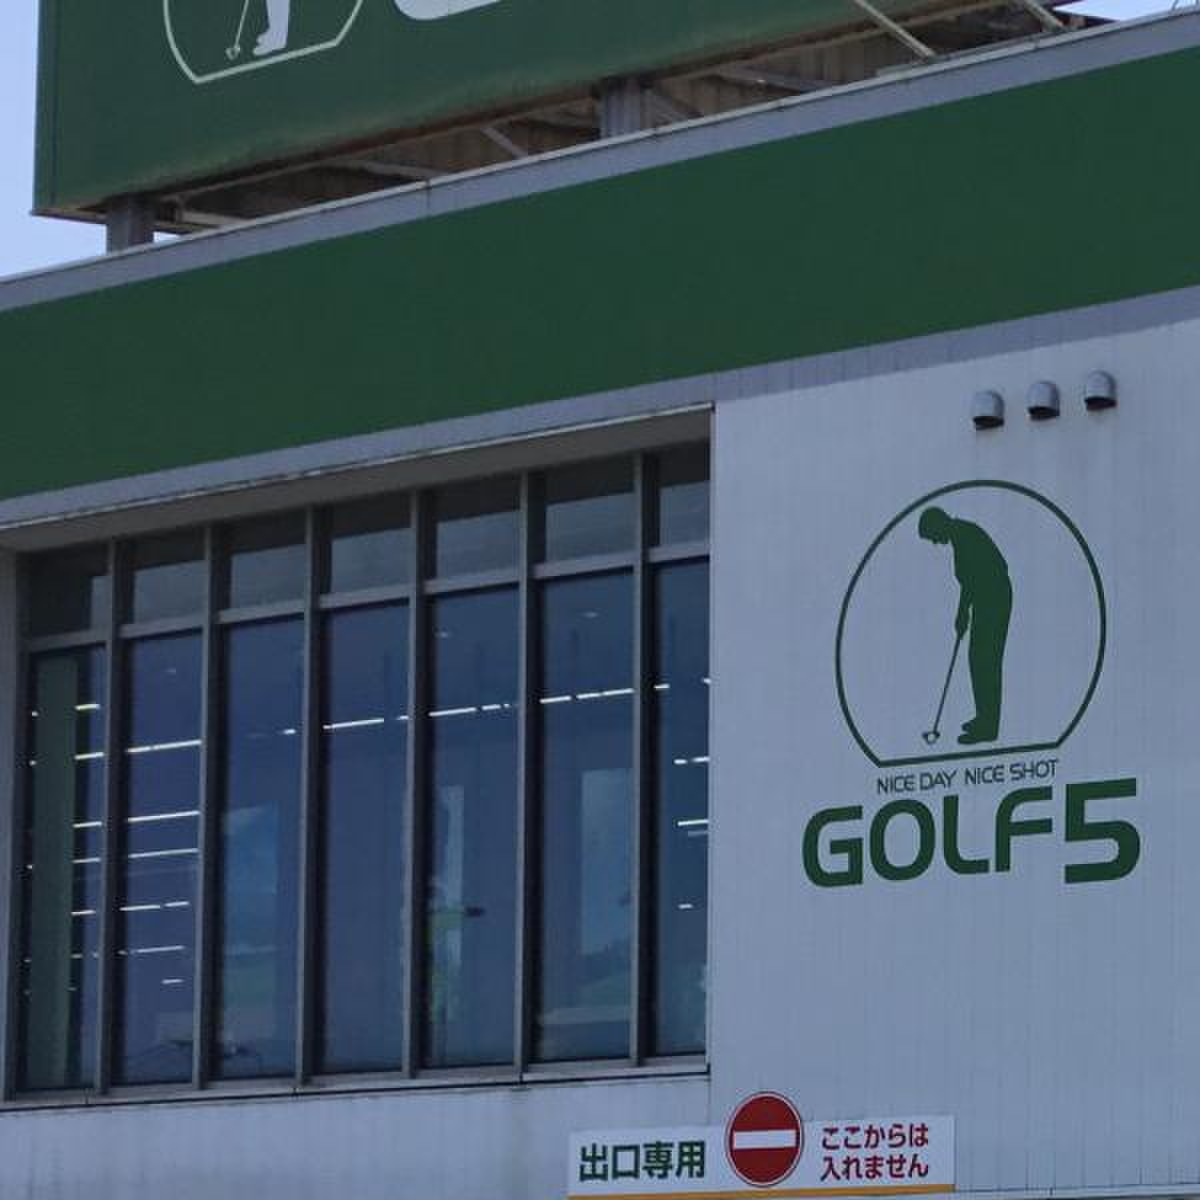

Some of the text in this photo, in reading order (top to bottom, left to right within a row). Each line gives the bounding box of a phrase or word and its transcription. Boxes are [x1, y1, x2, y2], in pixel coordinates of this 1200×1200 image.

[877, 758, 1058, 795] NICE DAY NICE SHOT
[802, 777, 1141, 888] GOLF5
[822, 1122, 929, 1151] ここからは
[580, 1140, 705, 1182] 出口専用
[820, 1153, 929, 1182] 入れません
